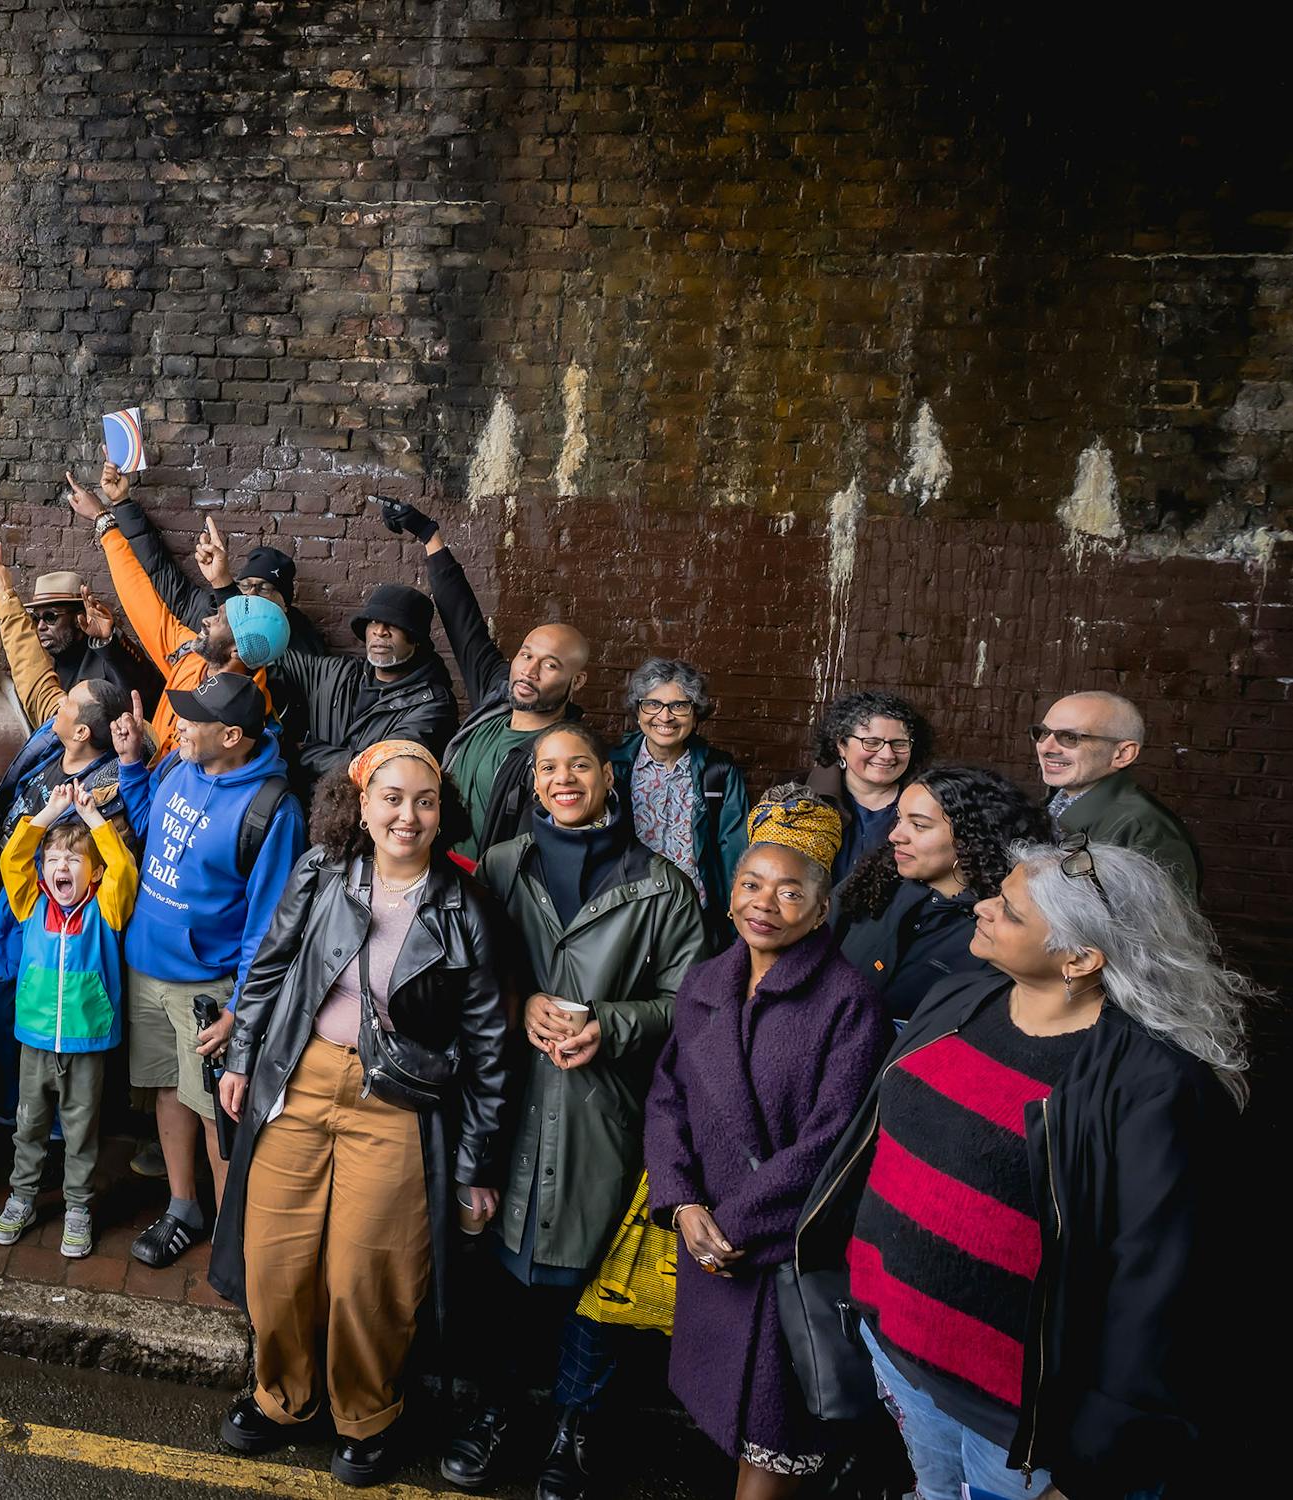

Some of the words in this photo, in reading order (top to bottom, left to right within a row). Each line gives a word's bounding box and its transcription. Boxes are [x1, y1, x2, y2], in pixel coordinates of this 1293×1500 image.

[166, 792, 211, 830] Men's
[161, 812, 197, 849] Walk
[147, 855, 181, 889] Talk
[165, 897, 189, 910] Strength
